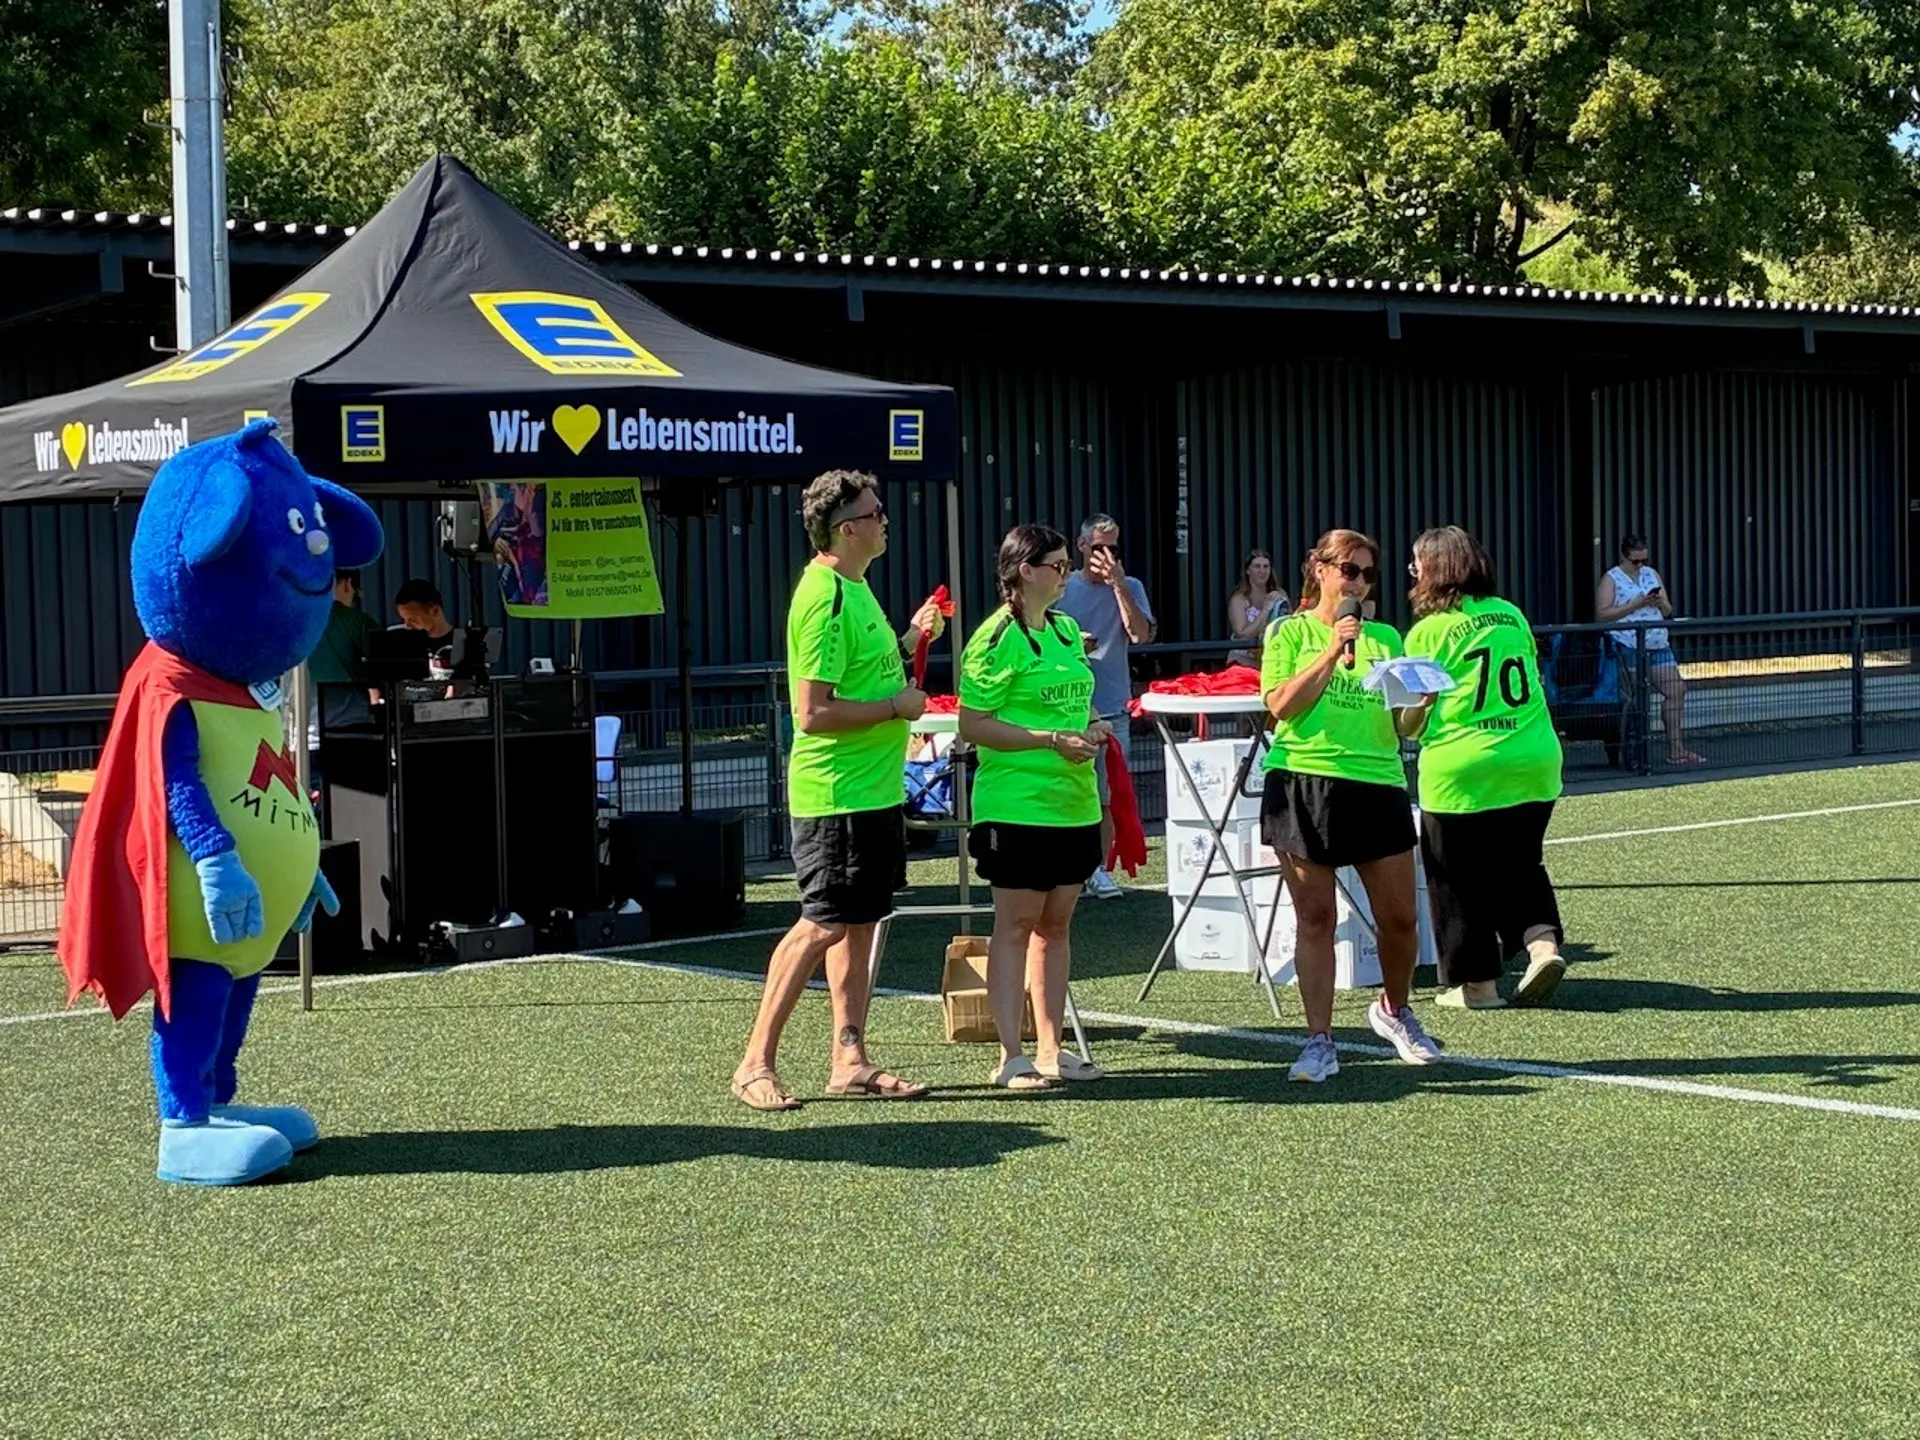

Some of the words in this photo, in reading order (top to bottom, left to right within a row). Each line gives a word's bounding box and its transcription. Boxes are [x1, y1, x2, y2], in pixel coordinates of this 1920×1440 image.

[552, 359, 665, 373] EDEKA
[489, 409, 546, 453] Wir
[607, 408, 803, 454] Lebensmittel.
[34, 431, 61, 472] Wir
[346, 449, 382, 458] EDEKA
[893, 448, 921, 456] EDEKA
[570, 486, 638, 508] entertainment
[1040, 682, 1069, 701] SPORT
